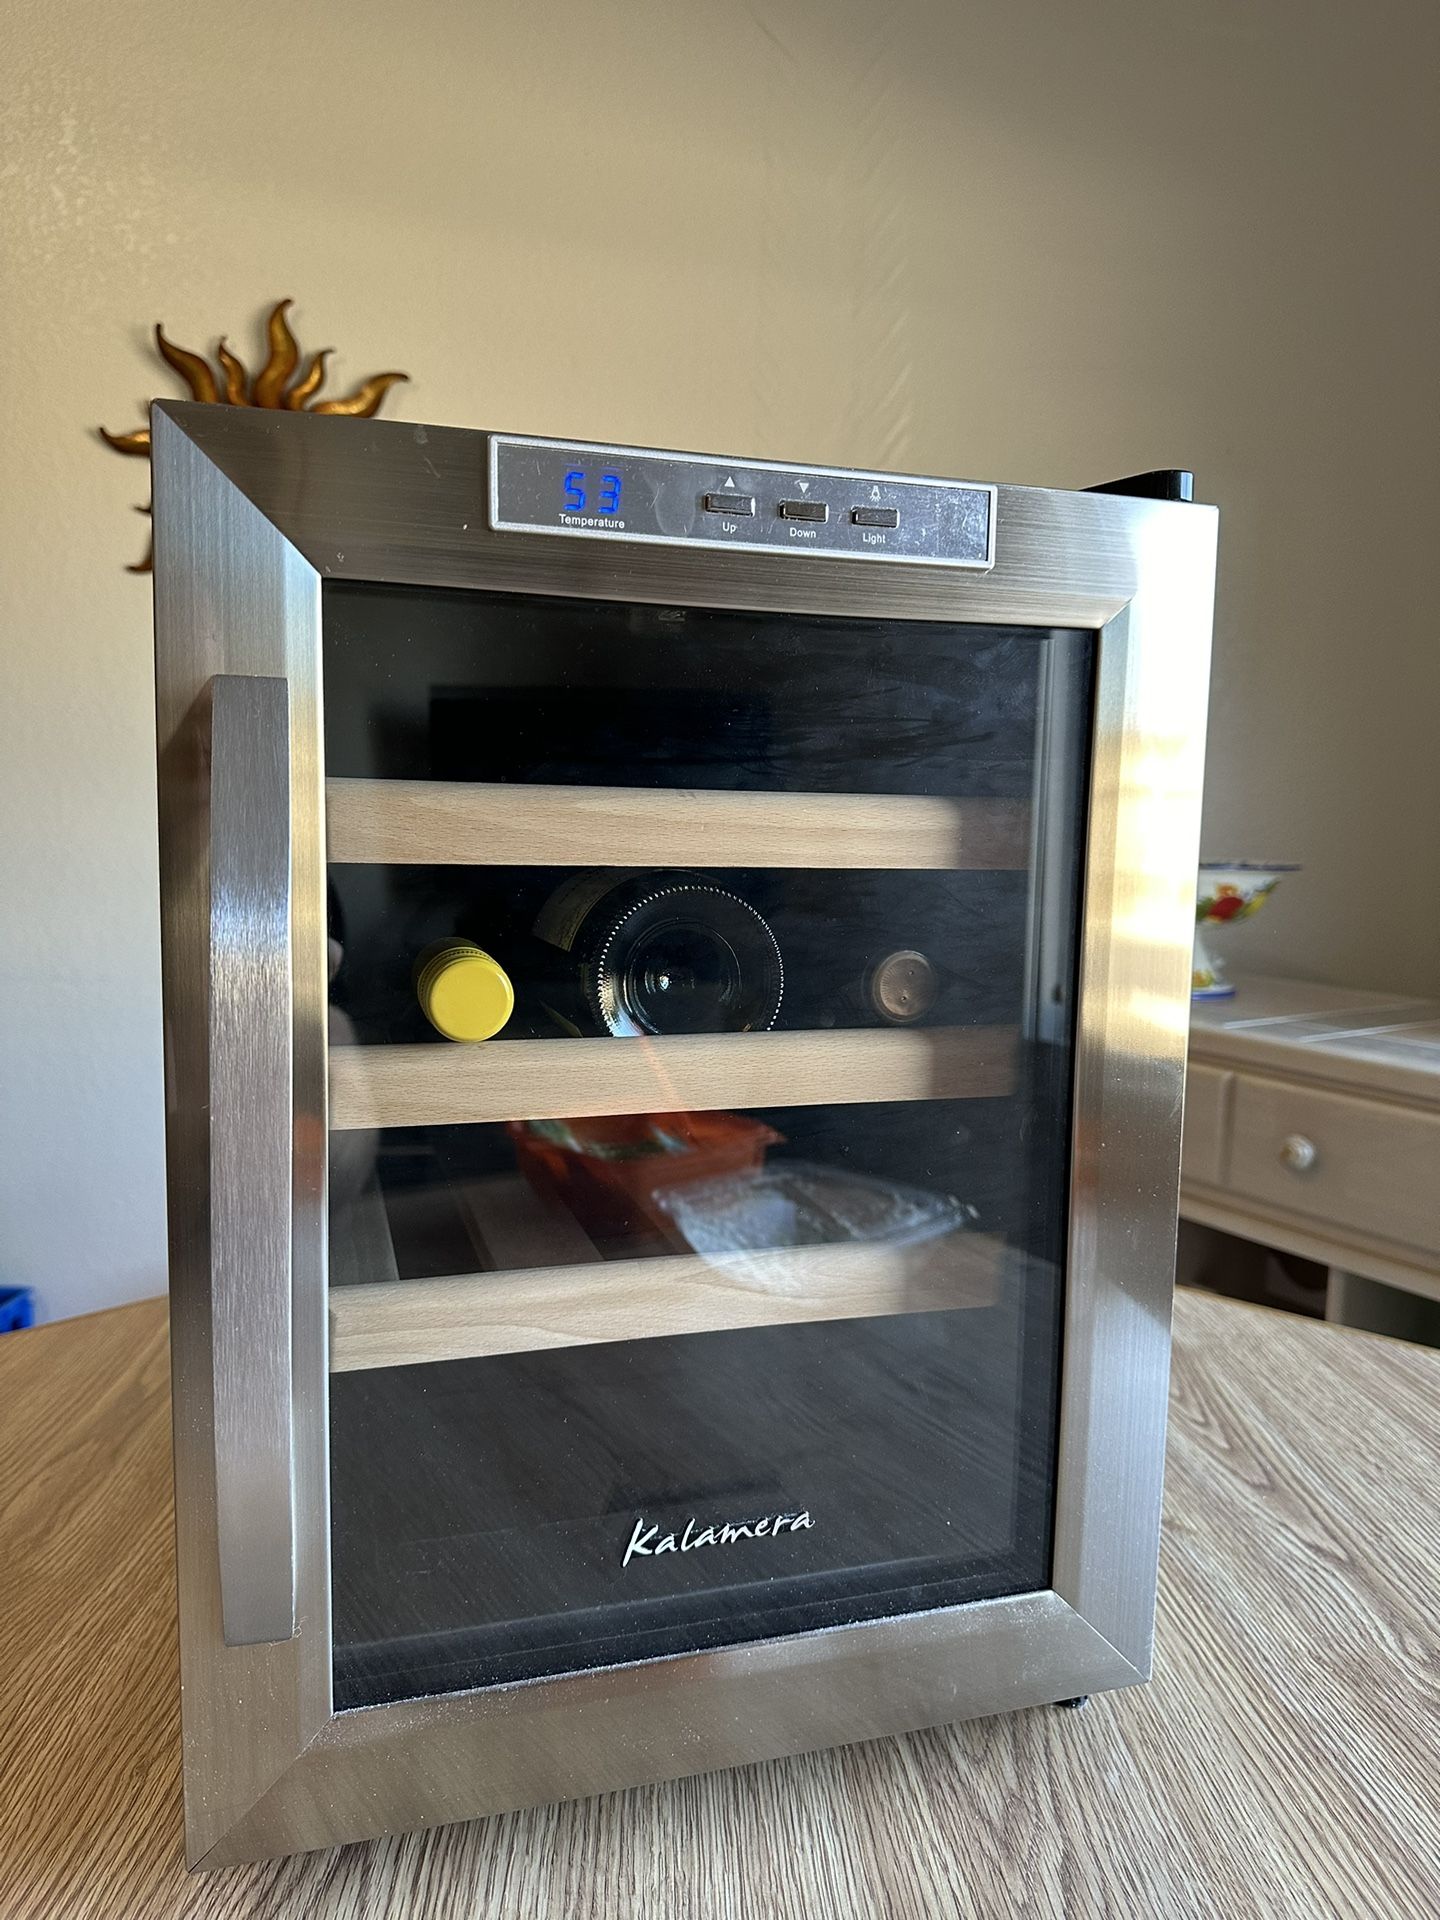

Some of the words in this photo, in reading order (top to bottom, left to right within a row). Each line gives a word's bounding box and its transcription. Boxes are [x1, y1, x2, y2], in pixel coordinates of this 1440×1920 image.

[564, 472, 622, 513] 53
[559, 513, 626, 529] Temperature
[722, 522, 737, 534] Up
[789, 528, 817, 539] Down
[862, 533, 887, 545] Light
[622, 1510, 815, 1568] Kalamera
